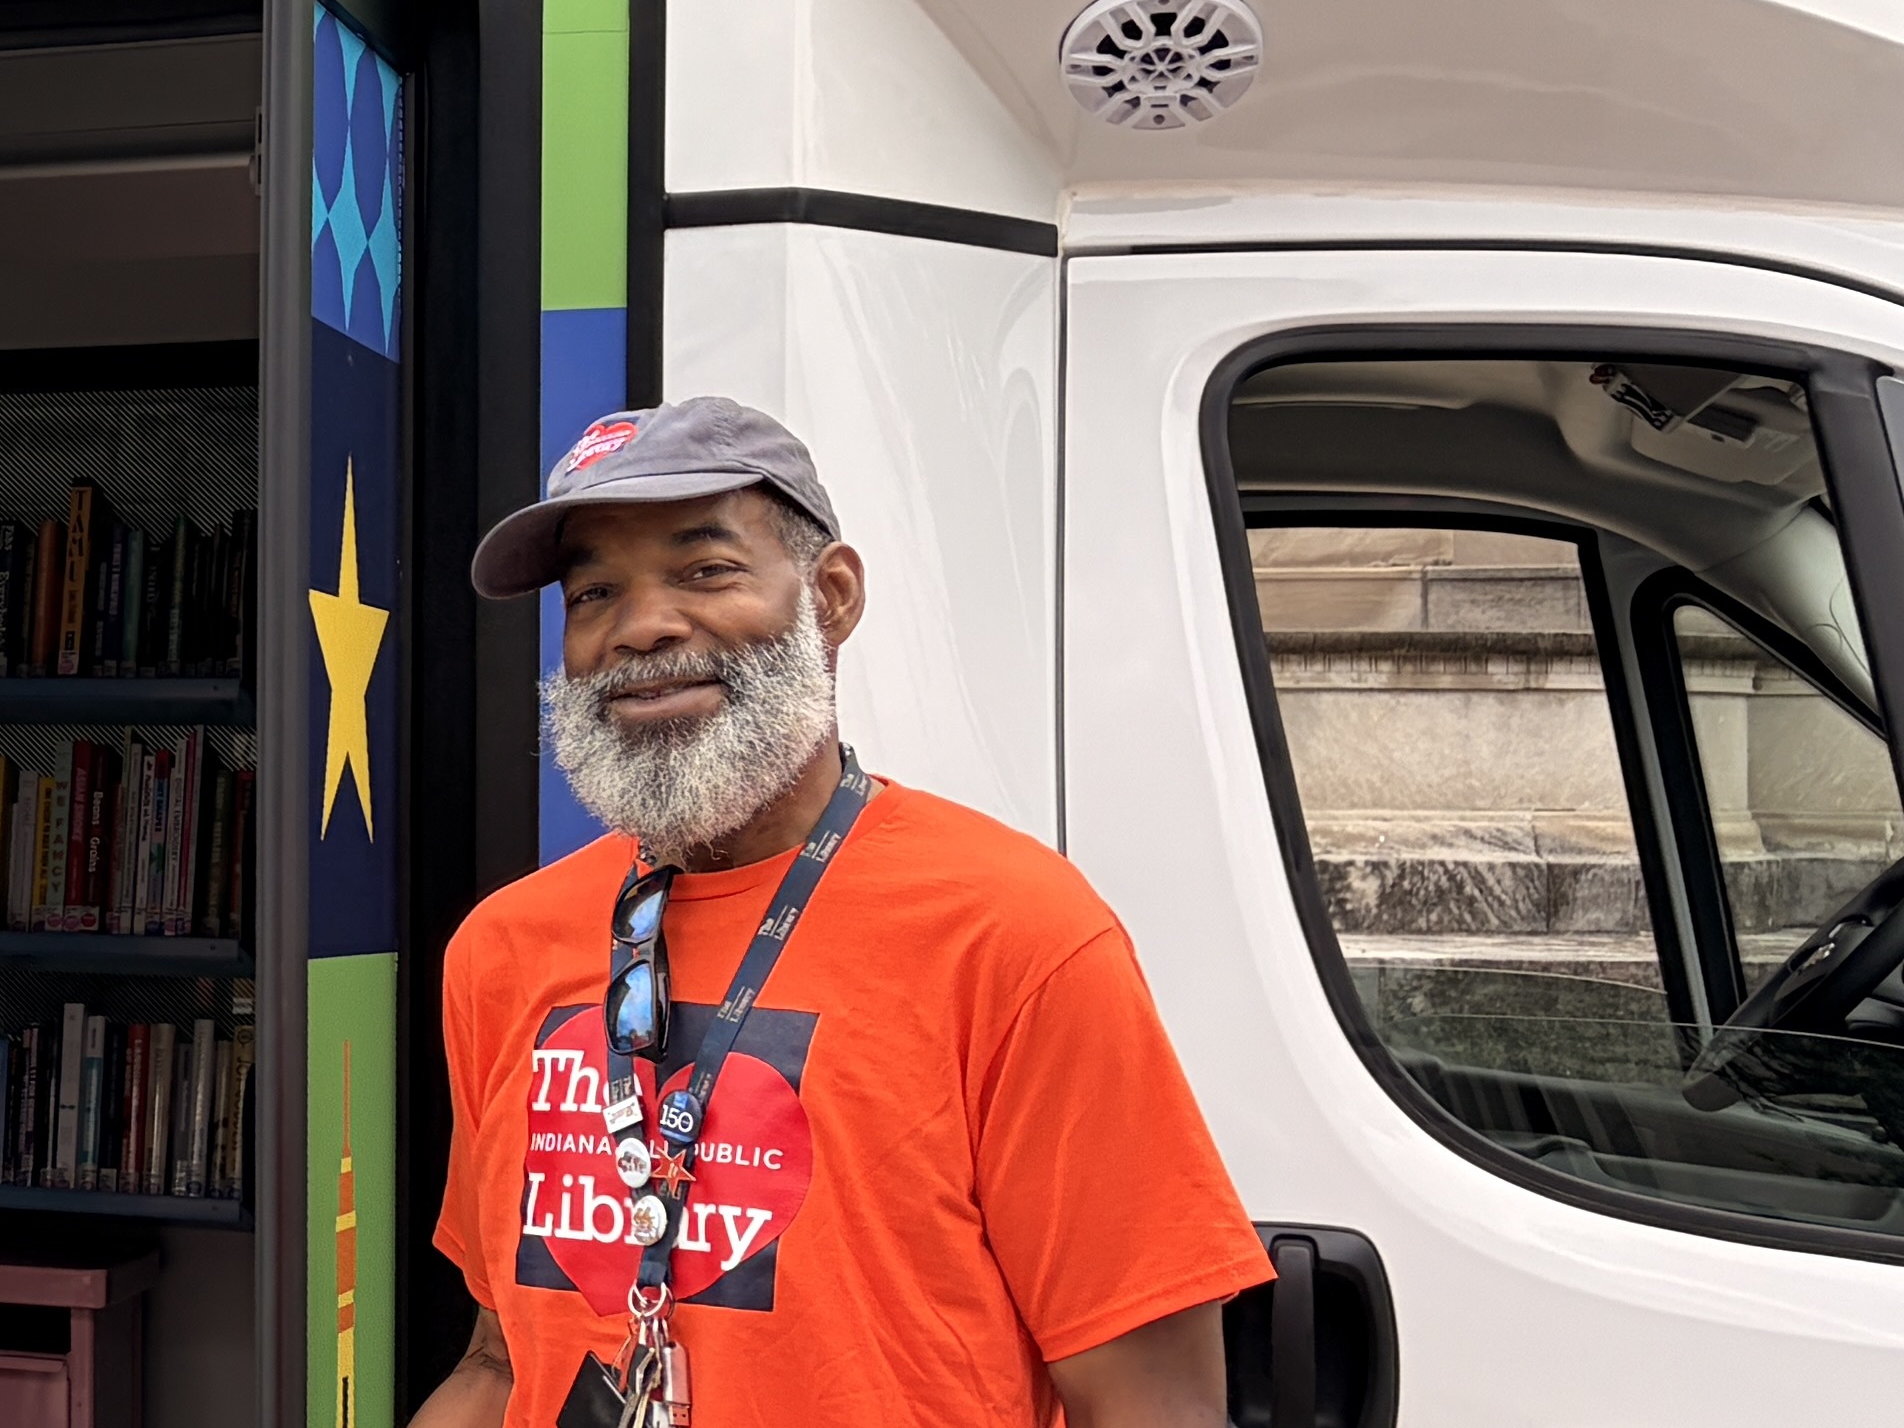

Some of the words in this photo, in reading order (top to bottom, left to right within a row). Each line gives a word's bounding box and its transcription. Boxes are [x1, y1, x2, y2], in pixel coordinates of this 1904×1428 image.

[92, 790, 104, 826] Beans
[88, 836, 100, 873] Grains
[659, 1104, 694, 1133] 150
